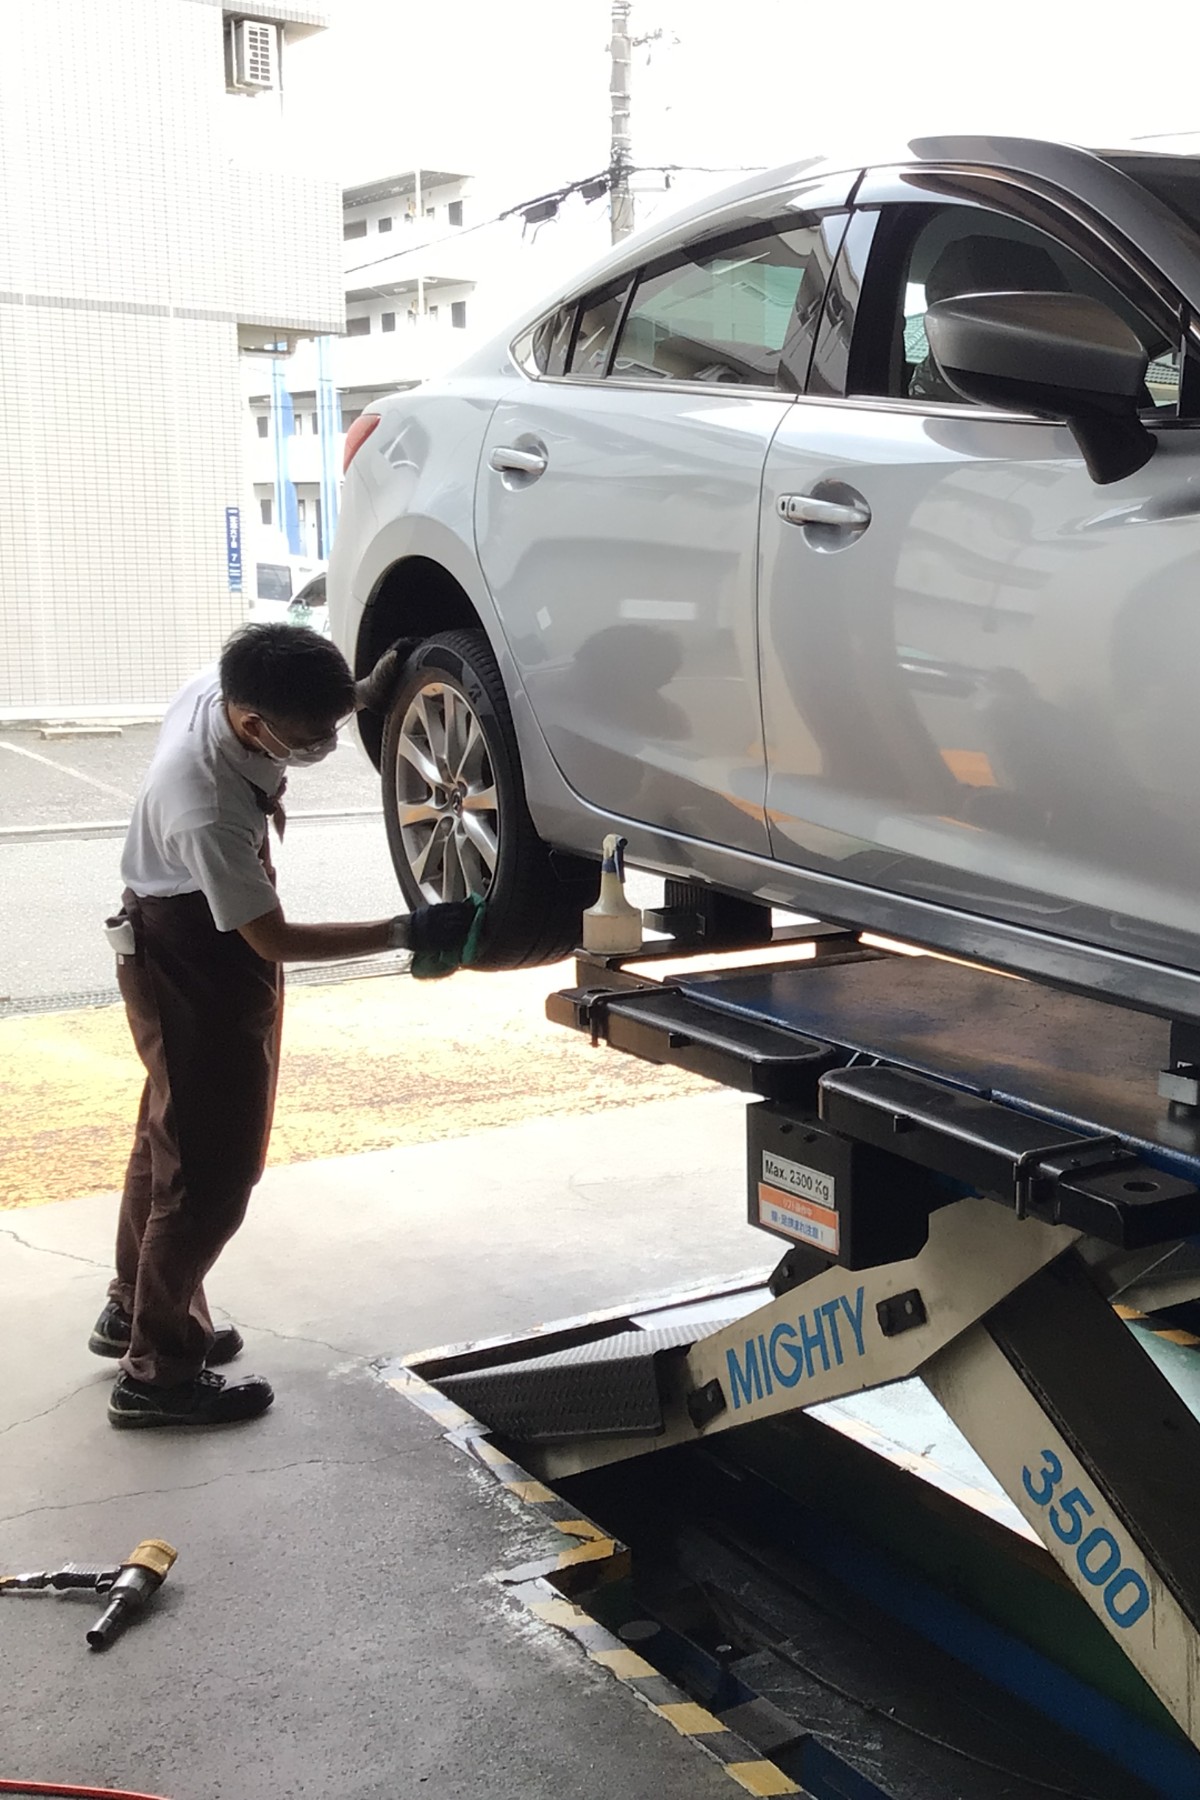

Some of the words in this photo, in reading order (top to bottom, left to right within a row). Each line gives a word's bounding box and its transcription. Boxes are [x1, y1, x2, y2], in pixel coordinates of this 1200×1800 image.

[765, 1159, 788, 1180] Max.
[815, 1179, 830, 1201] Kg
[725, 1286, 867, 1409] MIGHTY
[1022, 1448, 1151, 1629] 3500
